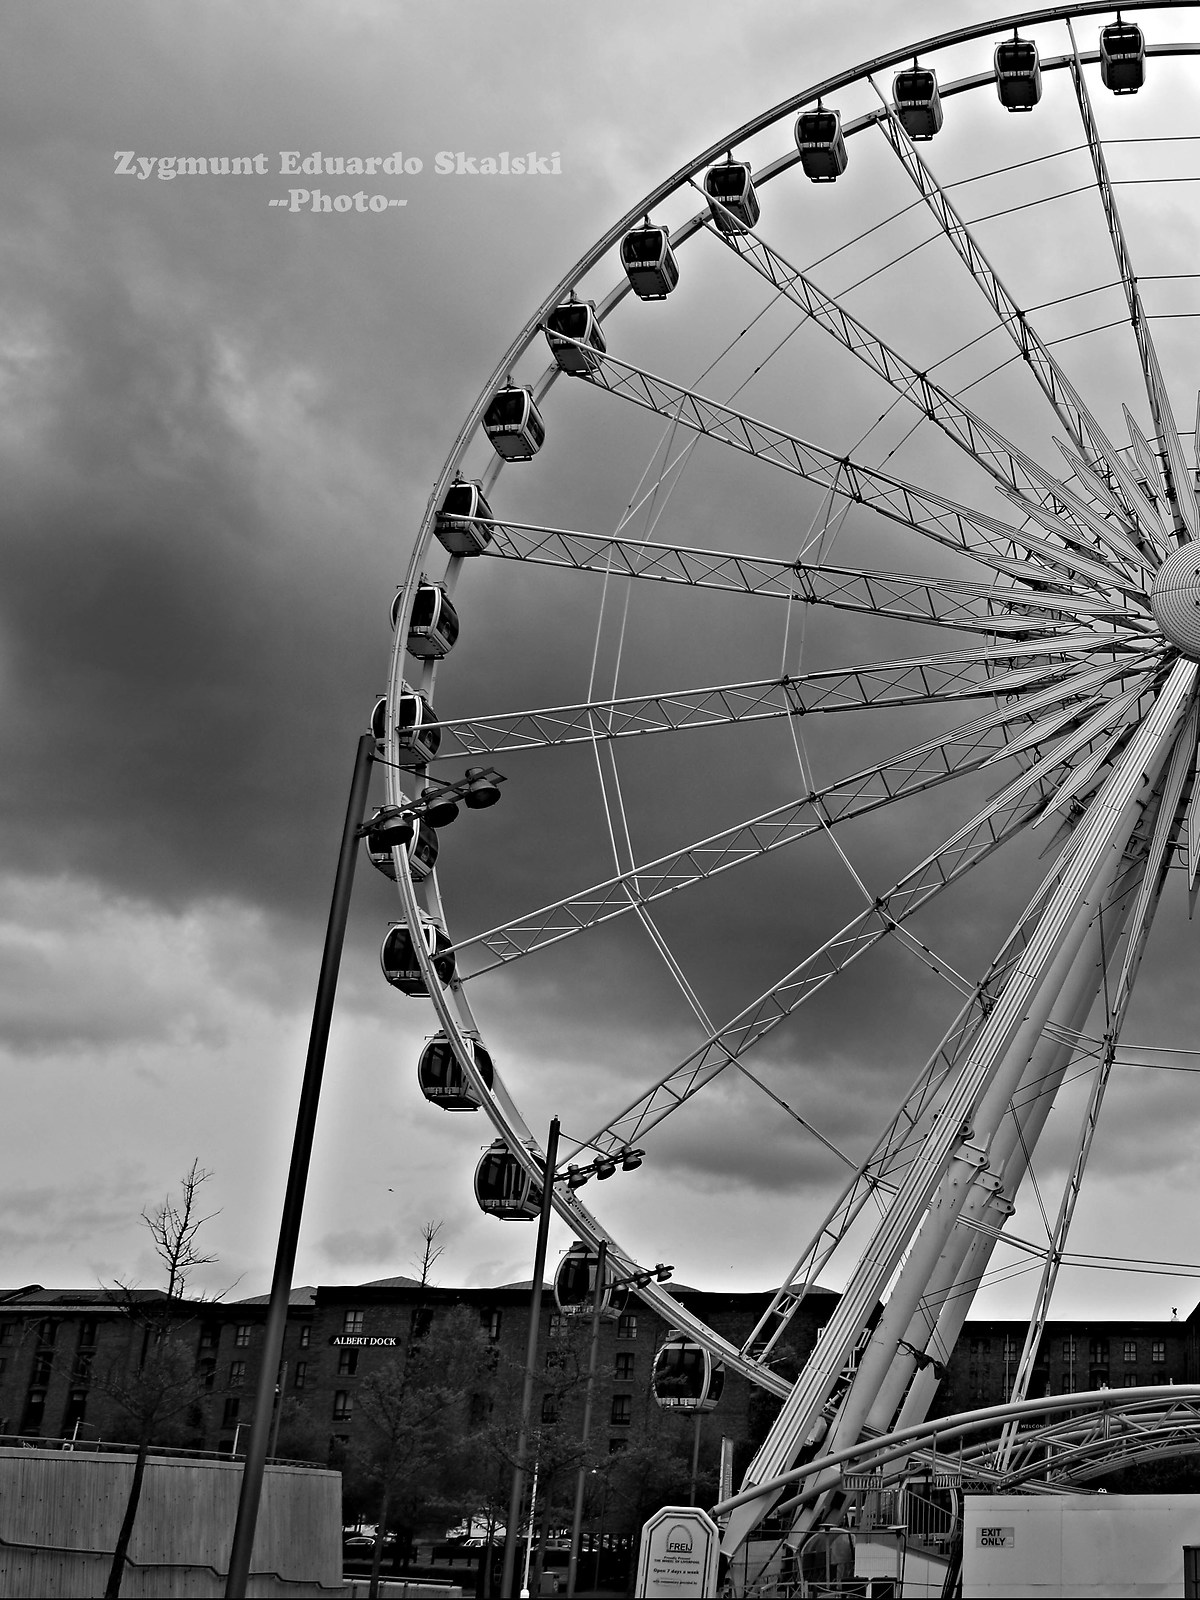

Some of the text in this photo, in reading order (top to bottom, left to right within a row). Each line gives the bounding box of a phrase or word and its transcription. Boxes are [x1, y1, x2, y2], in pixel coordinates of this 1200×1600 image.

[333, 1336, 396, 1346] ALBERT DOCK
[981, 1528, 1002, 1537] EXIT
[980, 1537, 1006, 1546] ONLY
[669, 1542, 693, 1551] FREIJ
